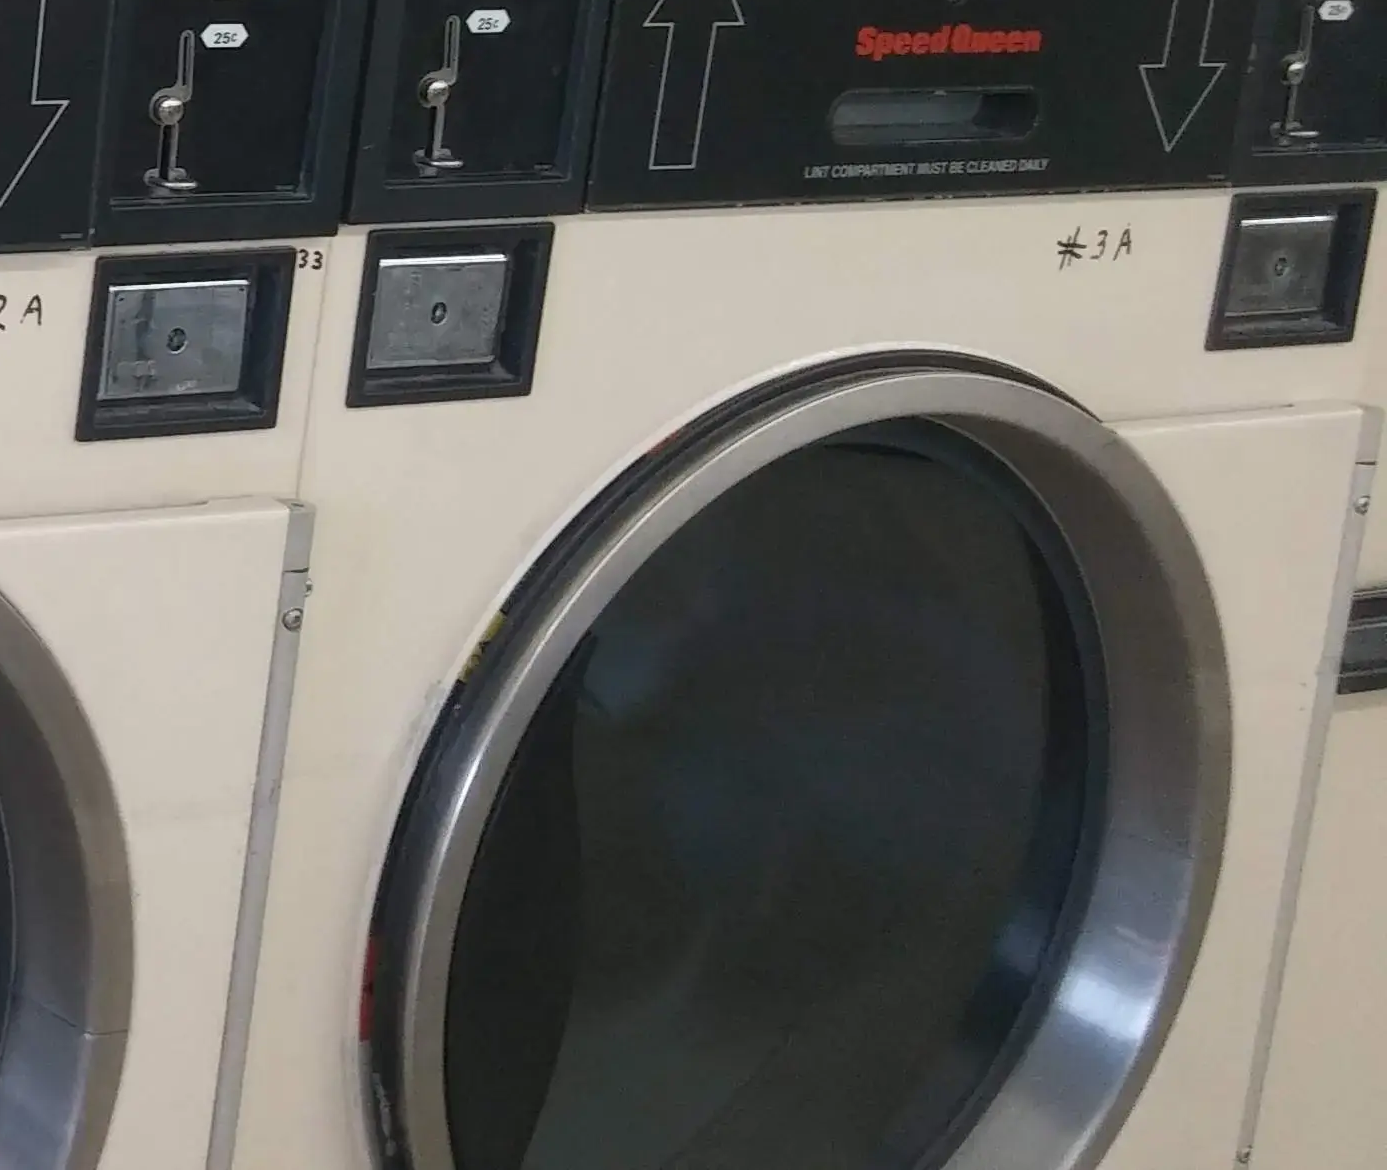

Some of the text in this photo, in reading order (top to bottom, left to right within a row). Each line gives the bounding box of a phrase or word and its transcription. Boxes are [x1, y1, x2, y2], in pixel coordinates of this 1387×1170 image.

[855, 22, 1042, 61] Speed Queen
[804, 157, 1051, 179] LINT COMPARTMENT MUST BE CLEANED DAILY
[297, 249, 324, 270] 33
